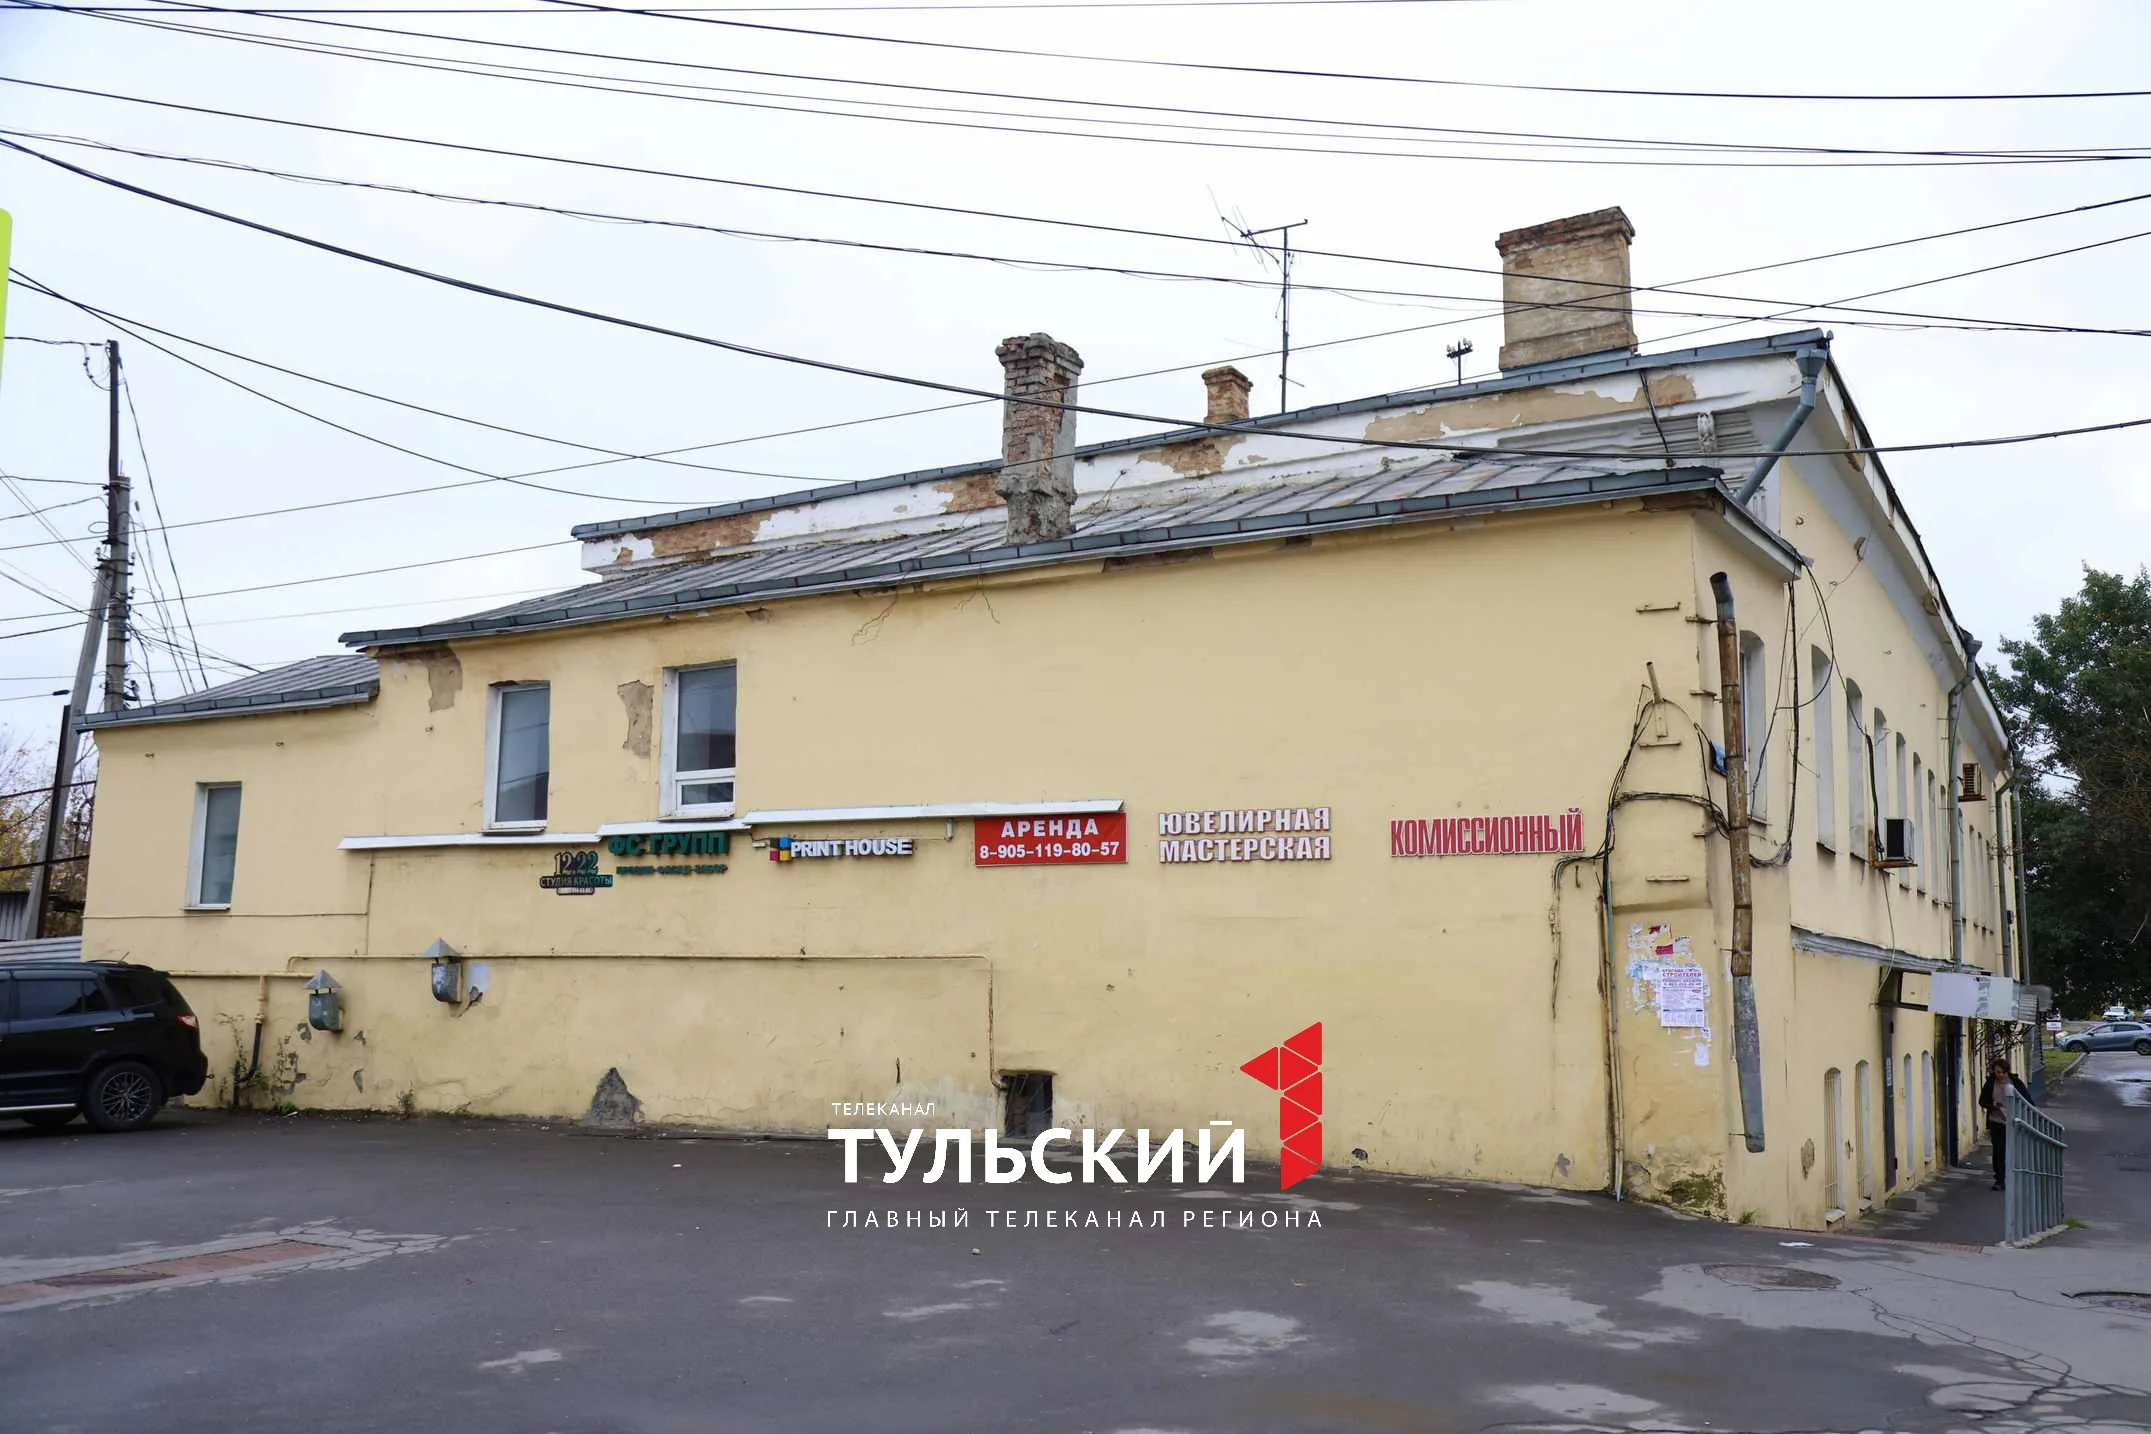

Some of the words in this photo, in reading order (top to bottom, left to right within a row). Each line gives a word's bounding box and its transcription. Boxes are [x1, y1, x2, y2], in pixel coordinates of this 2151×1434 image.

[1001, 818, 1099, 839] АРЕНДА
[1159, 807, 1331, 836] ЮВЕЛИРНАЯ
[1390, 807, 1584, 857] КОМИССИОННЫЙ
[608, 834, 645, 856] ФС
[649, 831, 728, 855] ГРУПП
[790, 840, 844, 858] PRINT
[845, 838, 913, 856] HOUSE
[979, 841, 1120, 859] 8-905-119-80-57
[1159, 836, 1331, 864] МАСТЕРСКАЯ
